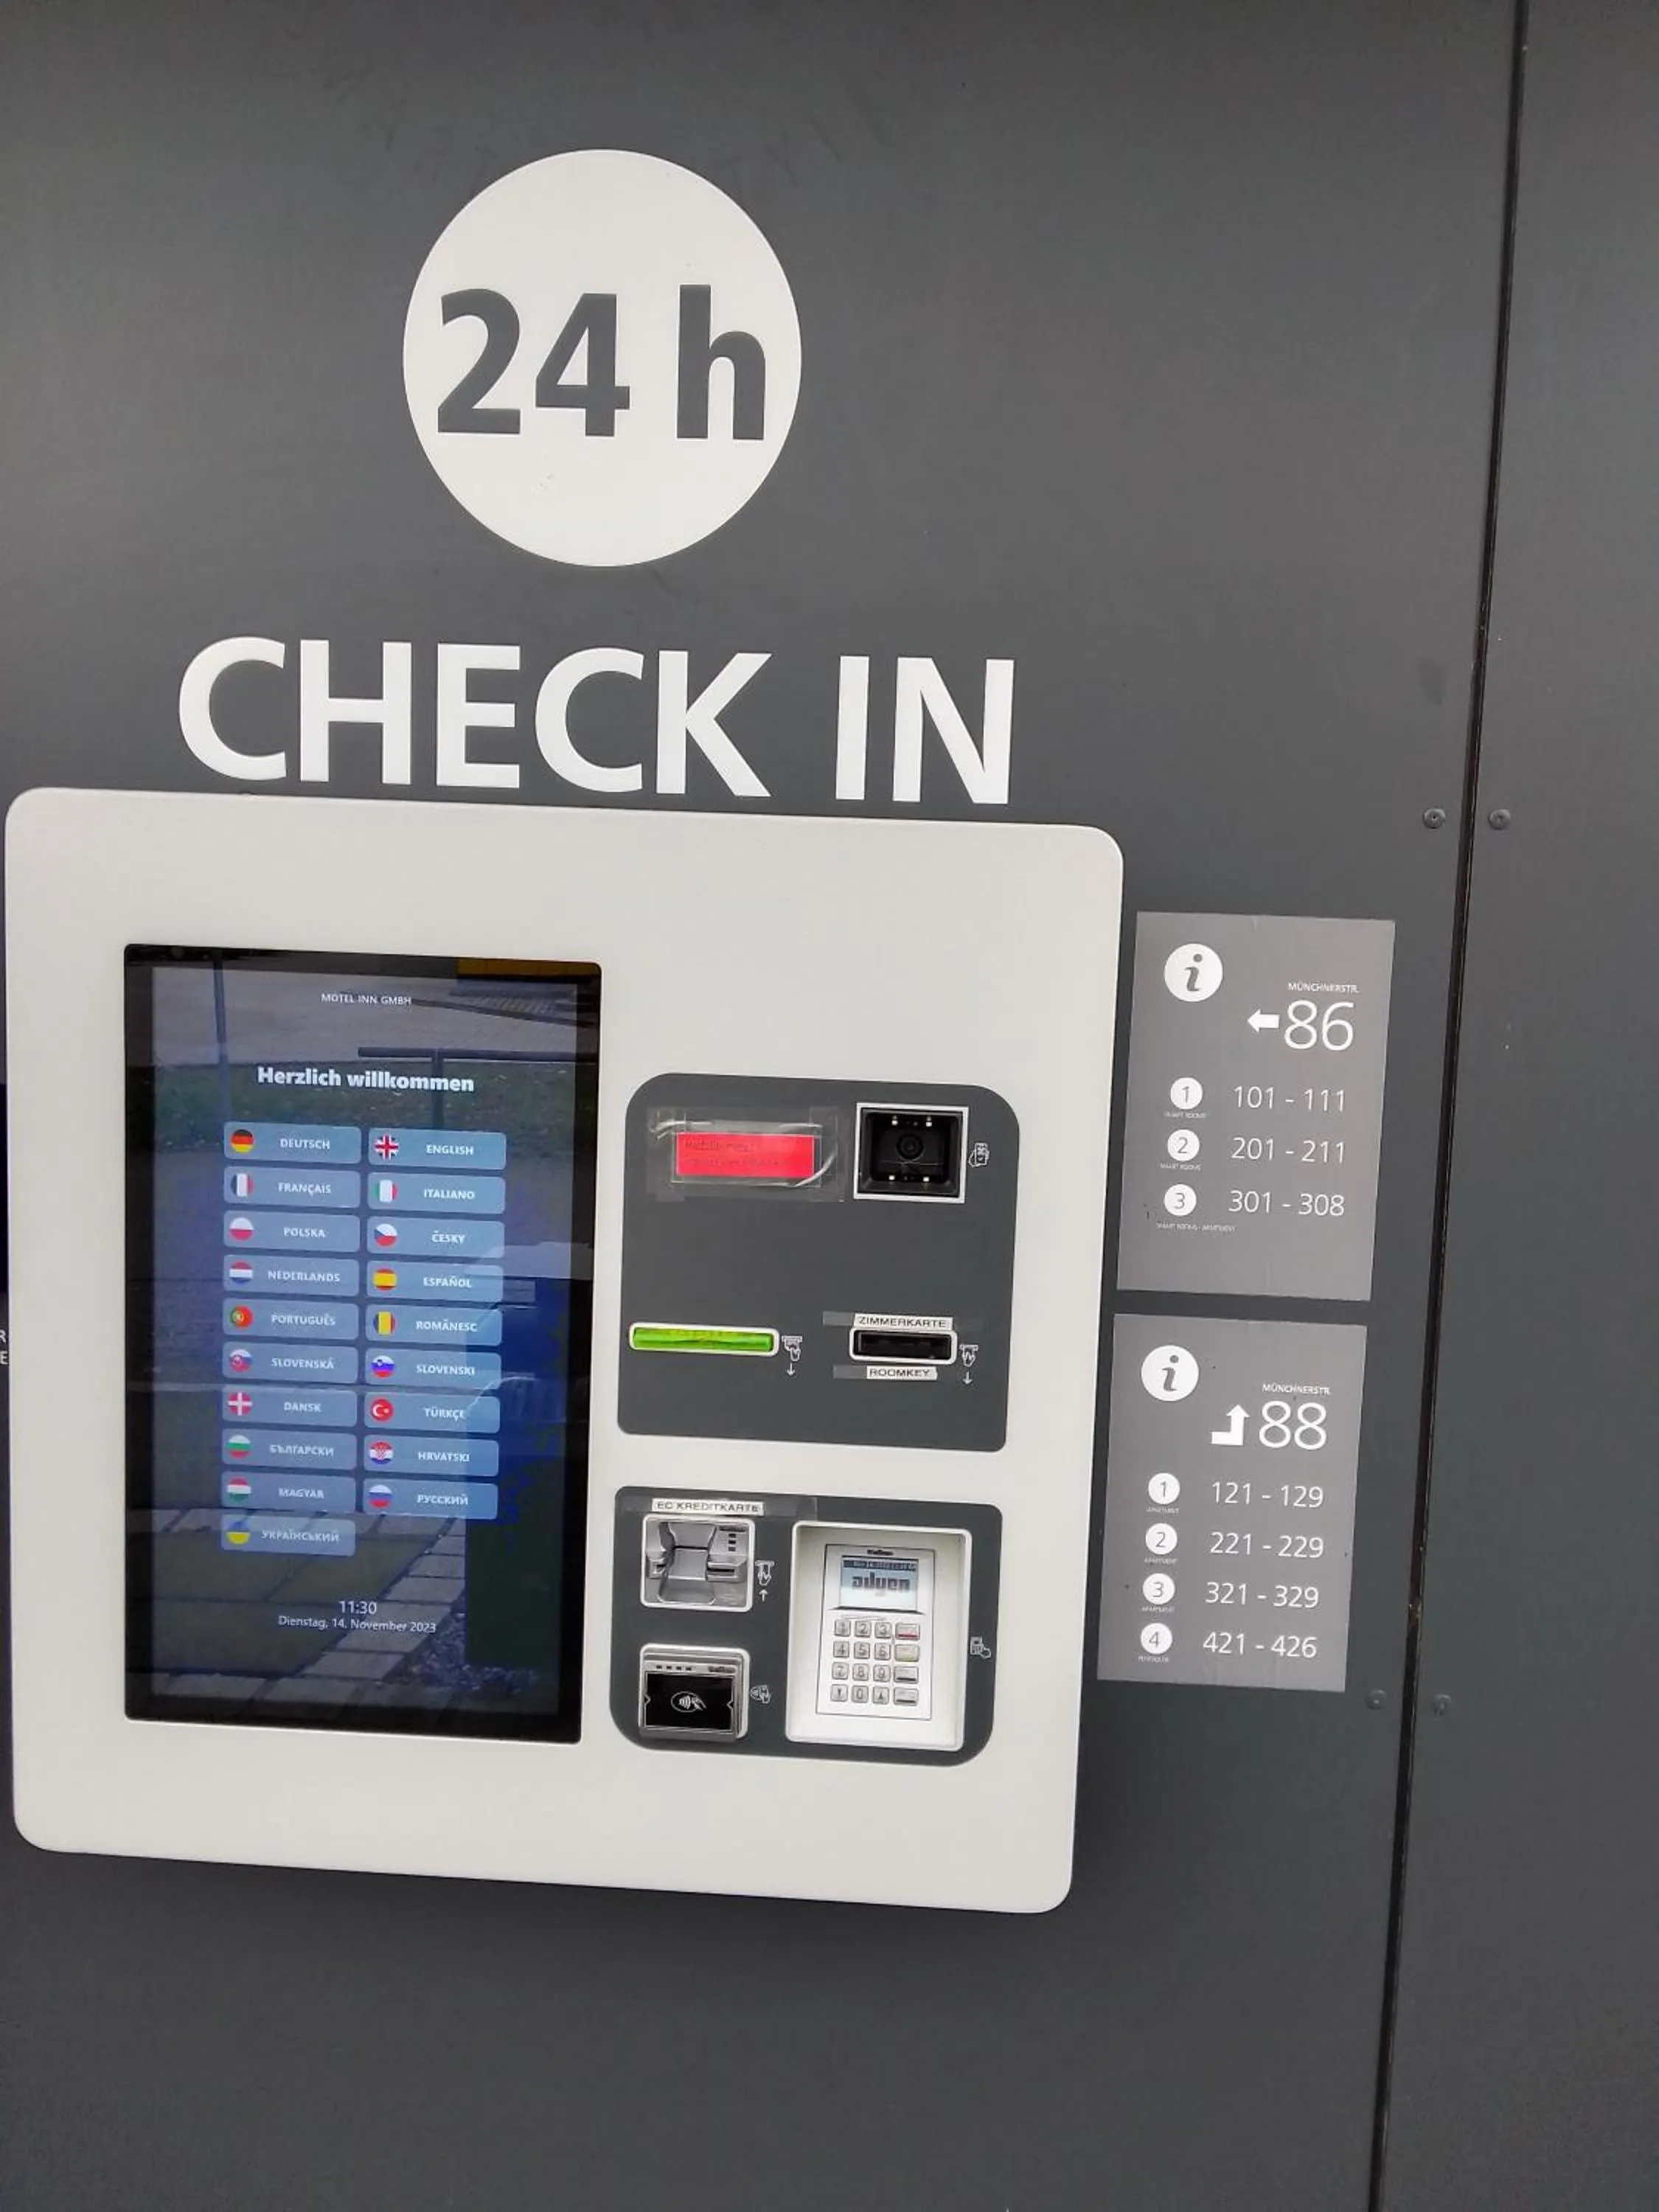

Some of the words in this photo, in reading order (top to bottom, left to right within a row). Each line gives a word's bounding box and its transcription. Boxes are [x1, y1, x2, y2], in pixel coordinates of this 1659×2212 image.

[437, 288, 630, 437] 24
[677, 285, 766, 440] h
[178, 636, 772, 797] CHECK
[835, 655, 1015, 804] IN
[321, 992, 355, 1004] MOTEL
[358, 994, 378, 1004] INN
[381, 995, 412, 1006] GMBH
[1284, 999, 1355, 1051] 86
[257, 1065, 341, 1088] Herzlich
[347, 1070, 475, 1093] willkommen
[1182, 1086, 1190, 1101] 1
[1234, 1086, 1275, 1108] 101
[1303, 1089, 1346, 1112] 111
[279, 1138, 330, 1150] DEUTSCH
[426, 1143, 474, 1155] ENGLISH
[1178, 1137, 1189, 1154] 2
[1231, 1137, 1275, 1161] 201
[1301, 1140, 1346, 1164] 211
[278, 1182, 331, 1197] FRANÇAIS
[423, 1189, 476, 1200] ITALIANO
[1174, 1192, 1186, 1210] 3
[1228, 1190, 1272, 1213] 301
[1298, 1193, 1345, 1216] 308
[283, 1226, 326, 1239] POLSKA
[431, 1229, 465, 1245] ČESKY
[267, 1270, 340, 1284] NEDERLANDS
[422, 1274, 472, 1289] ESPAÑOL
[271, 1313, 336, 1327] PORTUGUÊS
[858, 1316, 947, 1328] ZIMMERKARTE
[271, 1357, 335, 1370] SLOVENSKÁ
[416, 1363, 476, 1376] SLOVENSKI
[869, 1368, 931, 1377] ROOMKEY
[284, 1402, 321, 1413] DANSK
[424, 1405, 466, 1422] TÜRKÇE
[1259, 1400, 1327, 1450] 88
[417, 1451, 470, 1463] HRVATSKI
[278, 1487, 324, 1499] MAGYAR
[1160, 1481, 1166, 1498] 1
[1211, 1481, 1252, 1504] 121
[1280, 1484, 1324, 1508] 129
[417, 1492, 469, 1506] РУССКИЙ
[657, 1501, 674, 1510] EC
[676, 1502, 759, 1512] KREDITKARTE
[1156, 1531, 1166, 1547] 2
[1210, 1531, 1252, 1555] 221
[1277, 1536, 1324, 1558] 229
[1152, 1582, 1164, 1597] 3
[1205, 1582, 1248, 1605] 321
[1273, 1585, 1319, 1608] 329
[339, 1600, 378, 1614] 11:30
[278, 1616, 328, 1630] Dienstag,
[332, 1618, 347, 1629] 14.
[350, 1618, 407, 1632] November
[409, 1621, 437, 1632] 2023
[1149, 1630, 1159, 1647] 4
[1203, 1632, 1244, 1655] 421
[1270, 1635, 1317, 1658] 426
